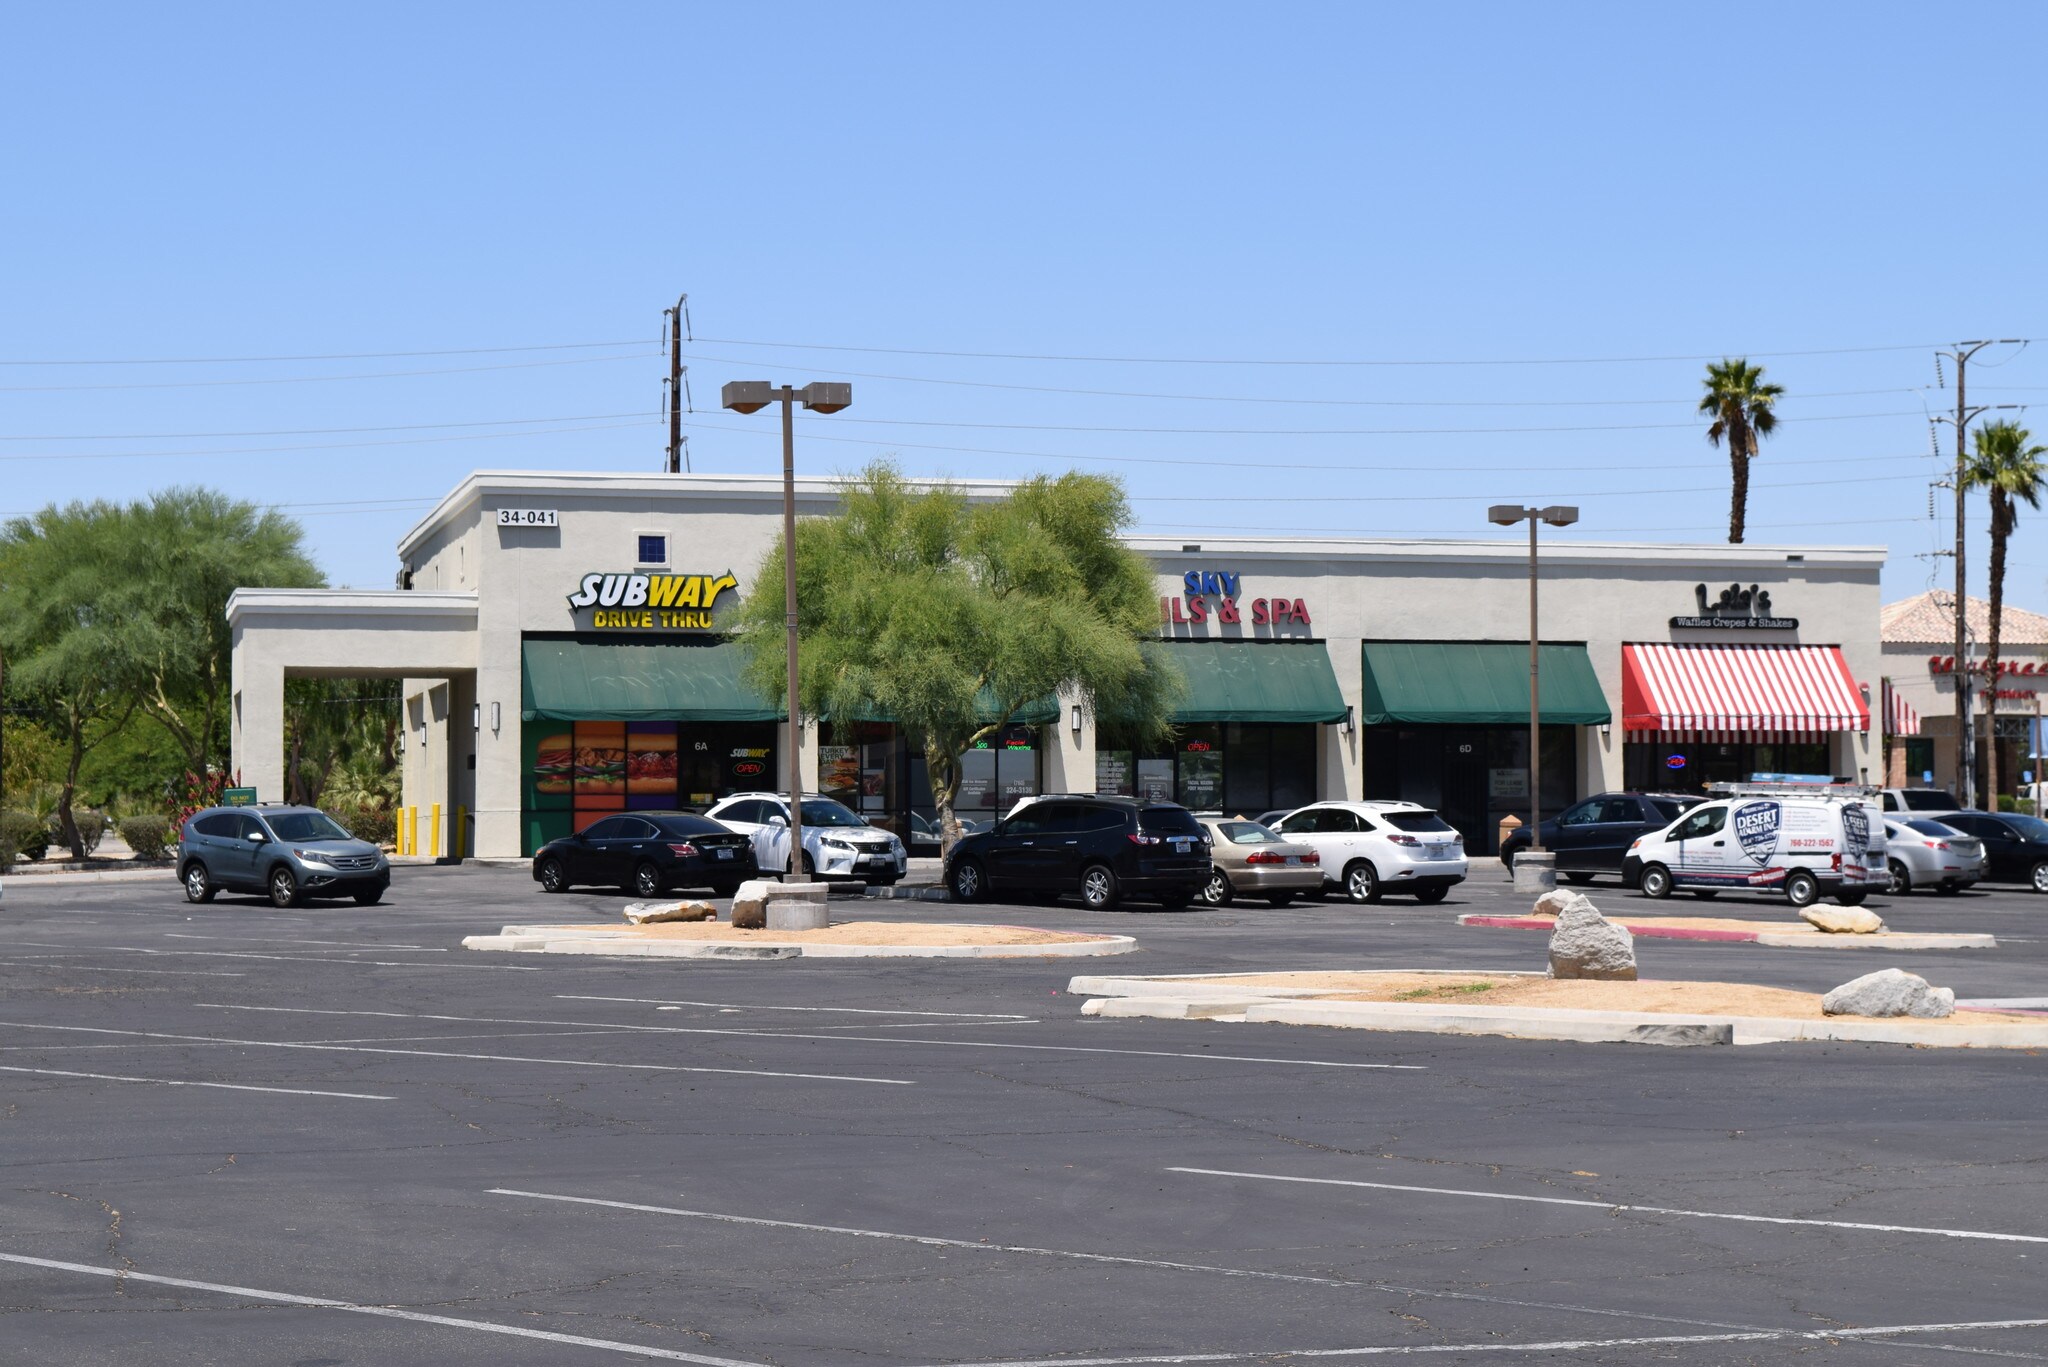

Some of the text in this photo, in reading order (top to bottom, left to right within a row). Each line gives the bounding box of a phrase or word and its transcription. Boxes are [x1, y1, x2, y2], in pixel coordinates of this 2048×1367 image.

[501, 510, 555, 525] 34-041
[1184, 571, 1240, 595] SKY
[569, 572, 737, 609] SUBWAY
[1219, 598, 1241, 624] &
[1252, 598, 1311, 624] SPA
[594, 611, 712, 629] DRIVE THRU
[1677, 617, 1793, 629] Waffles Crepes & Shakes
[1979, 689, 2037, 699] PARMACY
[694, 742, 708, 751] 6A
[1187, 743, 1211, 751] OPEN
[1459, 744, 1472, 753] 6D
[730, 748, 770, 758] SUBWAY
[736, 764, 761, 773] OPEN
[1736, 809, 1777, 829] DESERT
